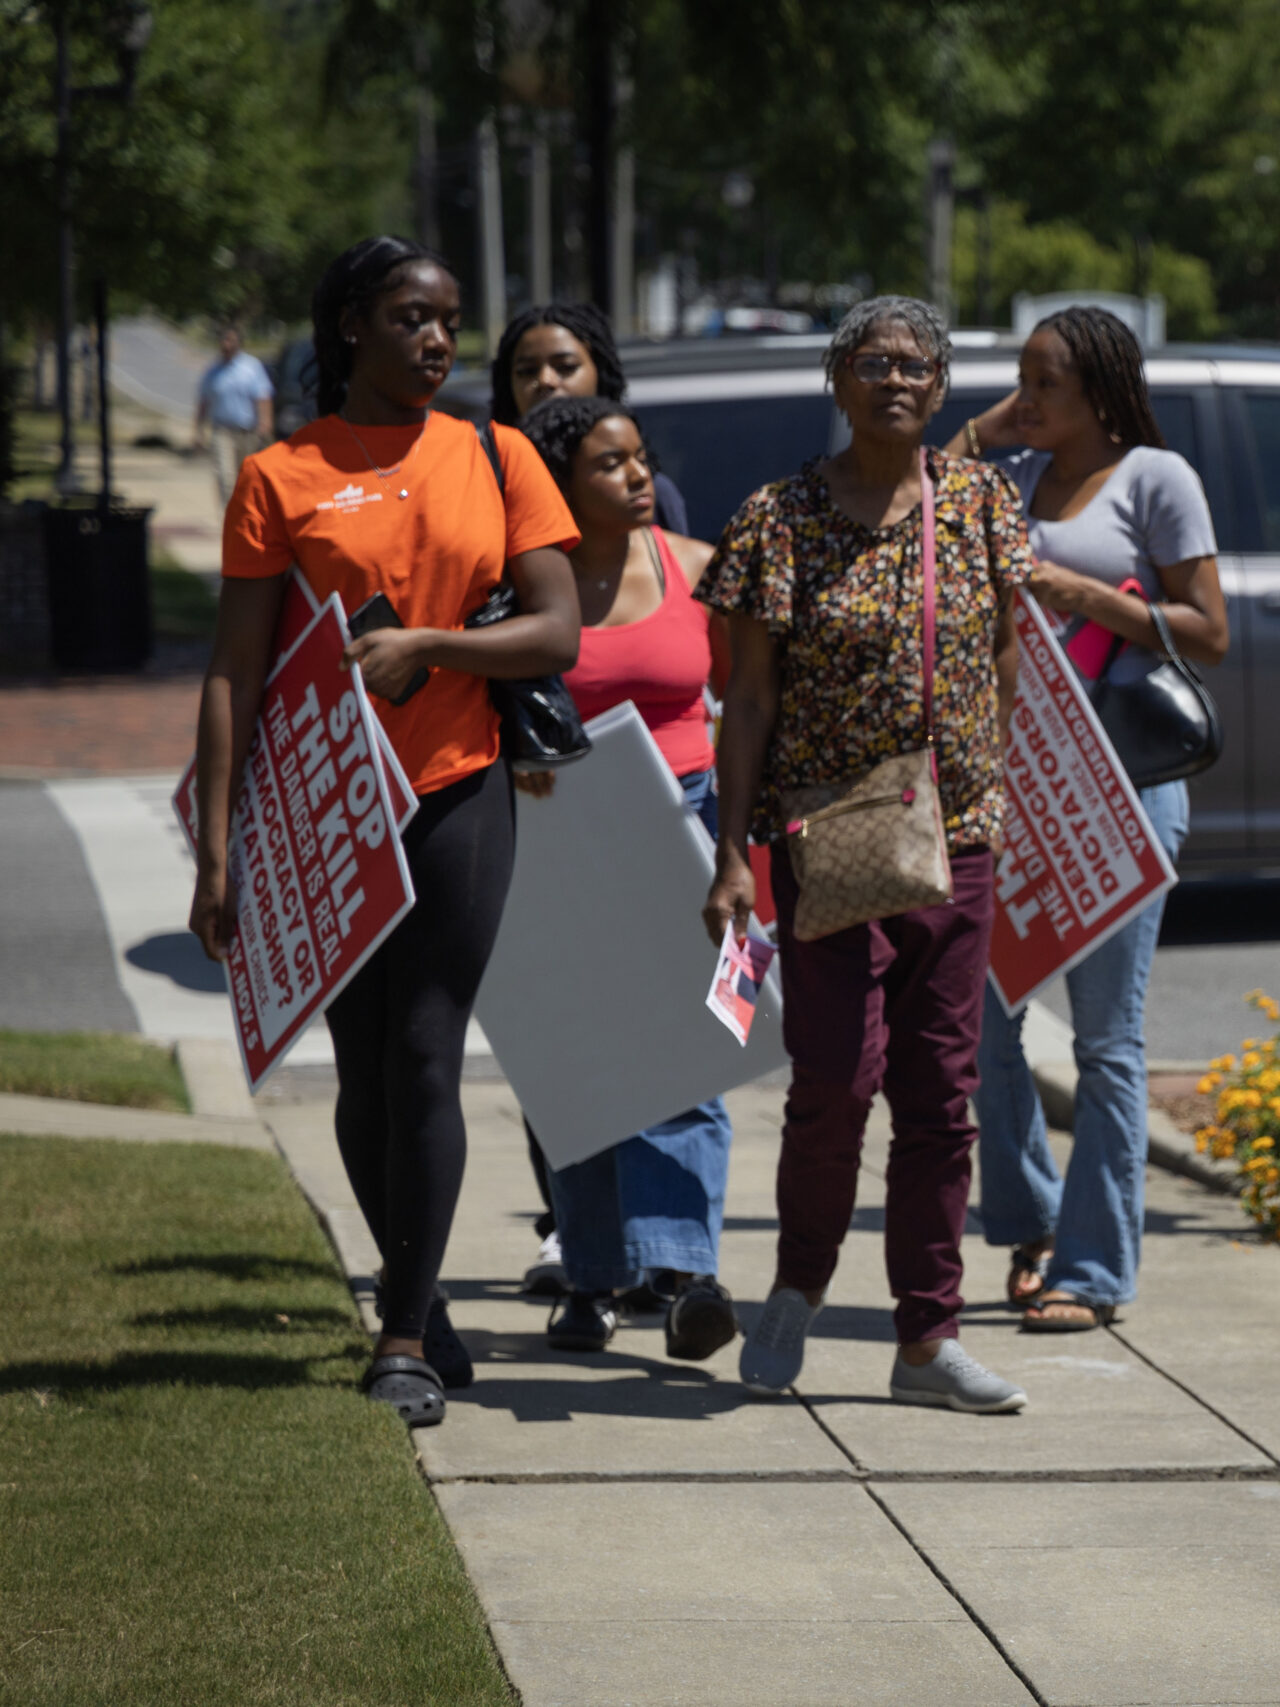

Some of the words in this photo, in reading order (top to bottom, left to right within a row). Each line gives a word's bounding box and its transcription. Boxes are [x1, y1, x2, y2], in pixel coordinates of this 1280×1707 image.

[1024, 621, 1061, 684] NOV.
[268, 693, 292, 757] THE
[1040, 704, 1069, 751] YOUR
[329, 689, 386, 850] STOP
[1012, 695, 1120, 899] DICTATORS
[280, 751, 317, 868] DANGER
[291, 681, 338, 812] THE
[316, 797, 366, 940] KILL
[1004, 730, 1099, 916] DEMOCRA
[1096, 812, 1124, 859] YOUR
[1109, 789, 1147, 858] VOTE
[236, 782, 294, 1010] CTATORSHIP?
[305, 861, 325, 899] IS
[995, 840, 1041, 942] TH
[1036, 879, 1075, 942] THE
[293, 939, 316, 997] OR
[313, 895, 342, 977] REAL
[246, 1030, 259, 1051] 5
